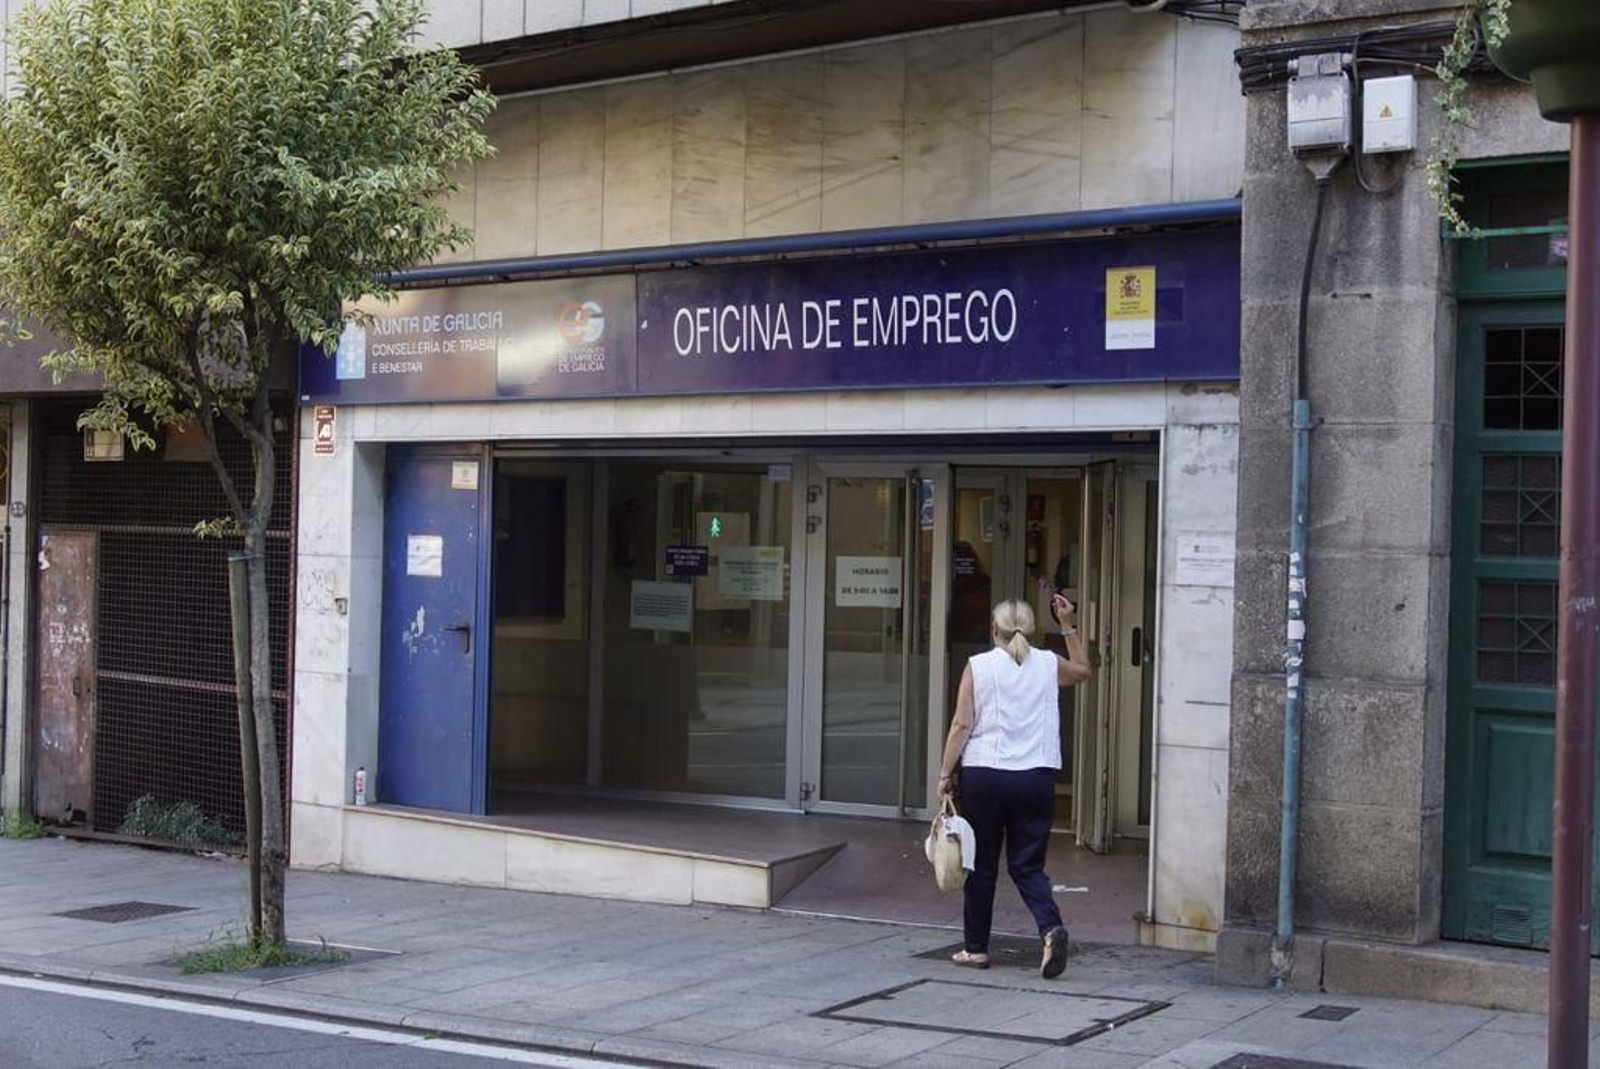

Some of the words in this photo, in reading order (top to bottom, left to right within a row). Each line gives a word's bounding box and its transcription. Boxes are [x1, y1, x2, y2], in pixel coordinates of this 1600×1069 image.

[373, 316, 420, 336] XUNTA
[422, 315, 441, 333] DE
[443, 311, 503, 332] GALICIA
[673, 303, 793, 355] OFICINA
[801, 299, 842, 349] DE
[853, 288, 1017, 348] EMPREGO
[372, 338, 441, 357] CONSELLERÍA
[443, 340, 457, 353] DE
[459, 337, 515, 352] TRABALO
[371, 363, 379, 374] E
[379, 361, 423, 374] BENESTAR
